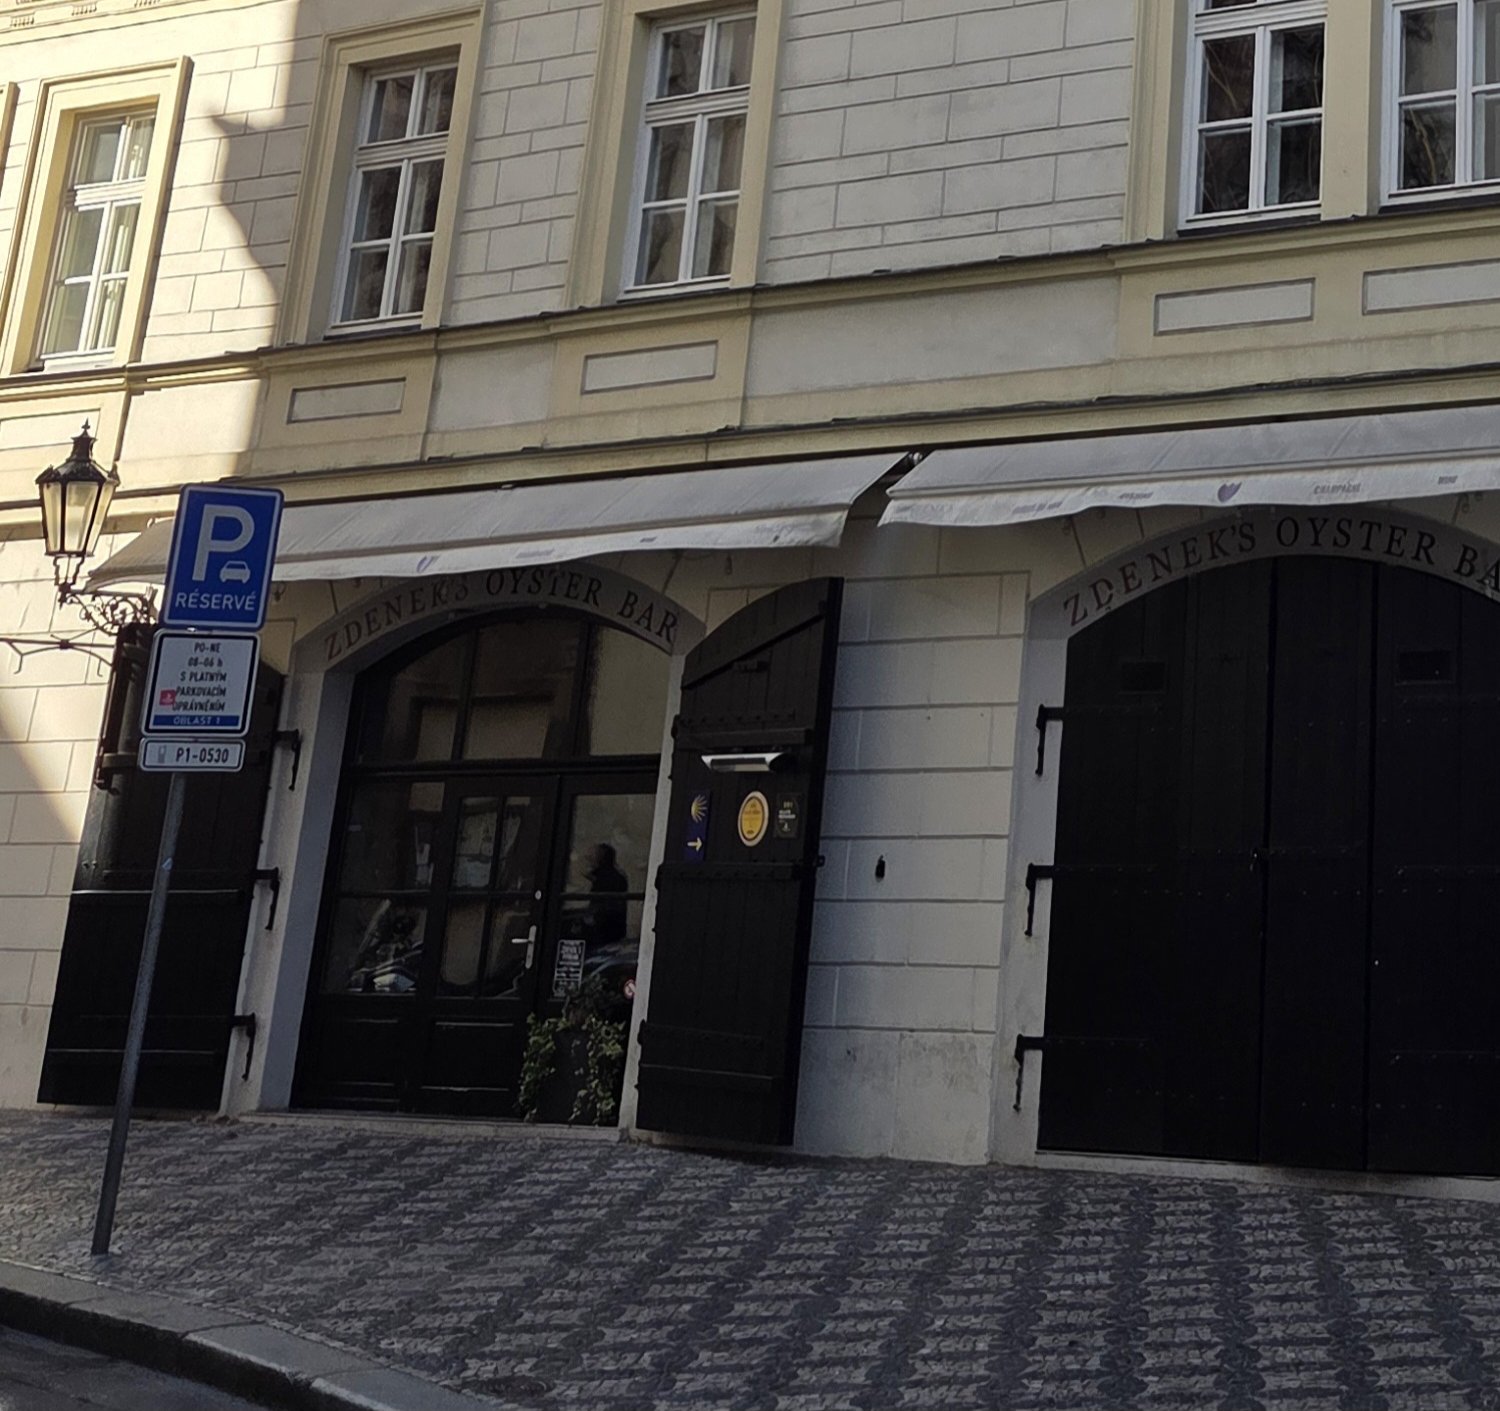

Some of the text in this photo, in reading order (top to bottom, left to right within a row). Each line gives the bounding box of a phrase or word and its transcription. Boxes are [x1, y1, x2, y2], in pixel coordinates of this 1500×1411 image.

[192, 504, 255, 582] P
[1063, 523, 1257, 627] ZDENEK'S
[1277, 517, 1437, 565] OYSTER
[175, 589, 256, 611] RÉSERVÉ
[486, 566, 601, 608] OYSTER
[618, 590, 681, 644] BAR
[194, 642, 221, 653] PO-NE
[180, 670, 227, 683] S PLATNÝM
[173, 716, 212, 725] OBLAST
[175, 747, 229, 763] P1-0530
